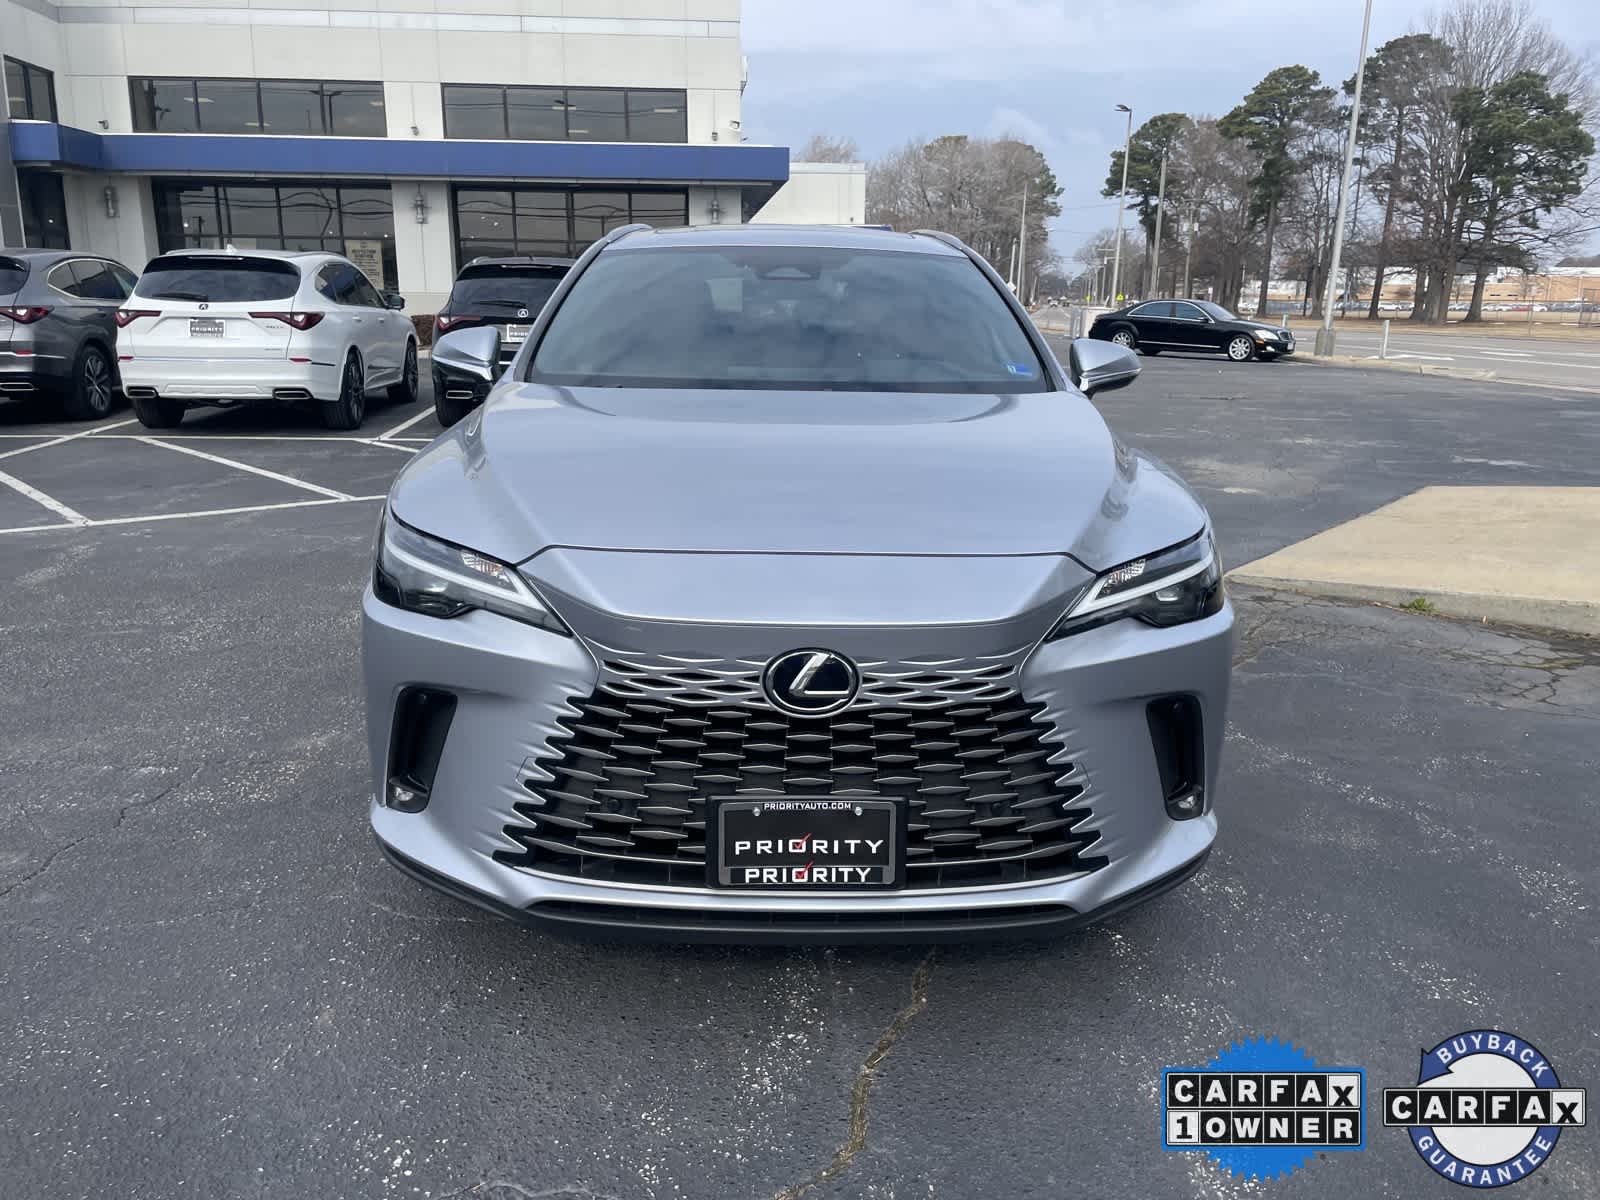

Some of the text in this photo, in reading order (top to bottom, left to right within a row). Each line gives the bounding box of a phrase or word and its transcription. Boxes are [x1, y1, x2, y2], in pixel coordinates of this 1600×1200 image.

[763, 802, 851, 811] PRIORITYAUTO.COM
[735, 839, 884, 855] PRIORITY
[745, 867, 871, 883] PRIORITY
